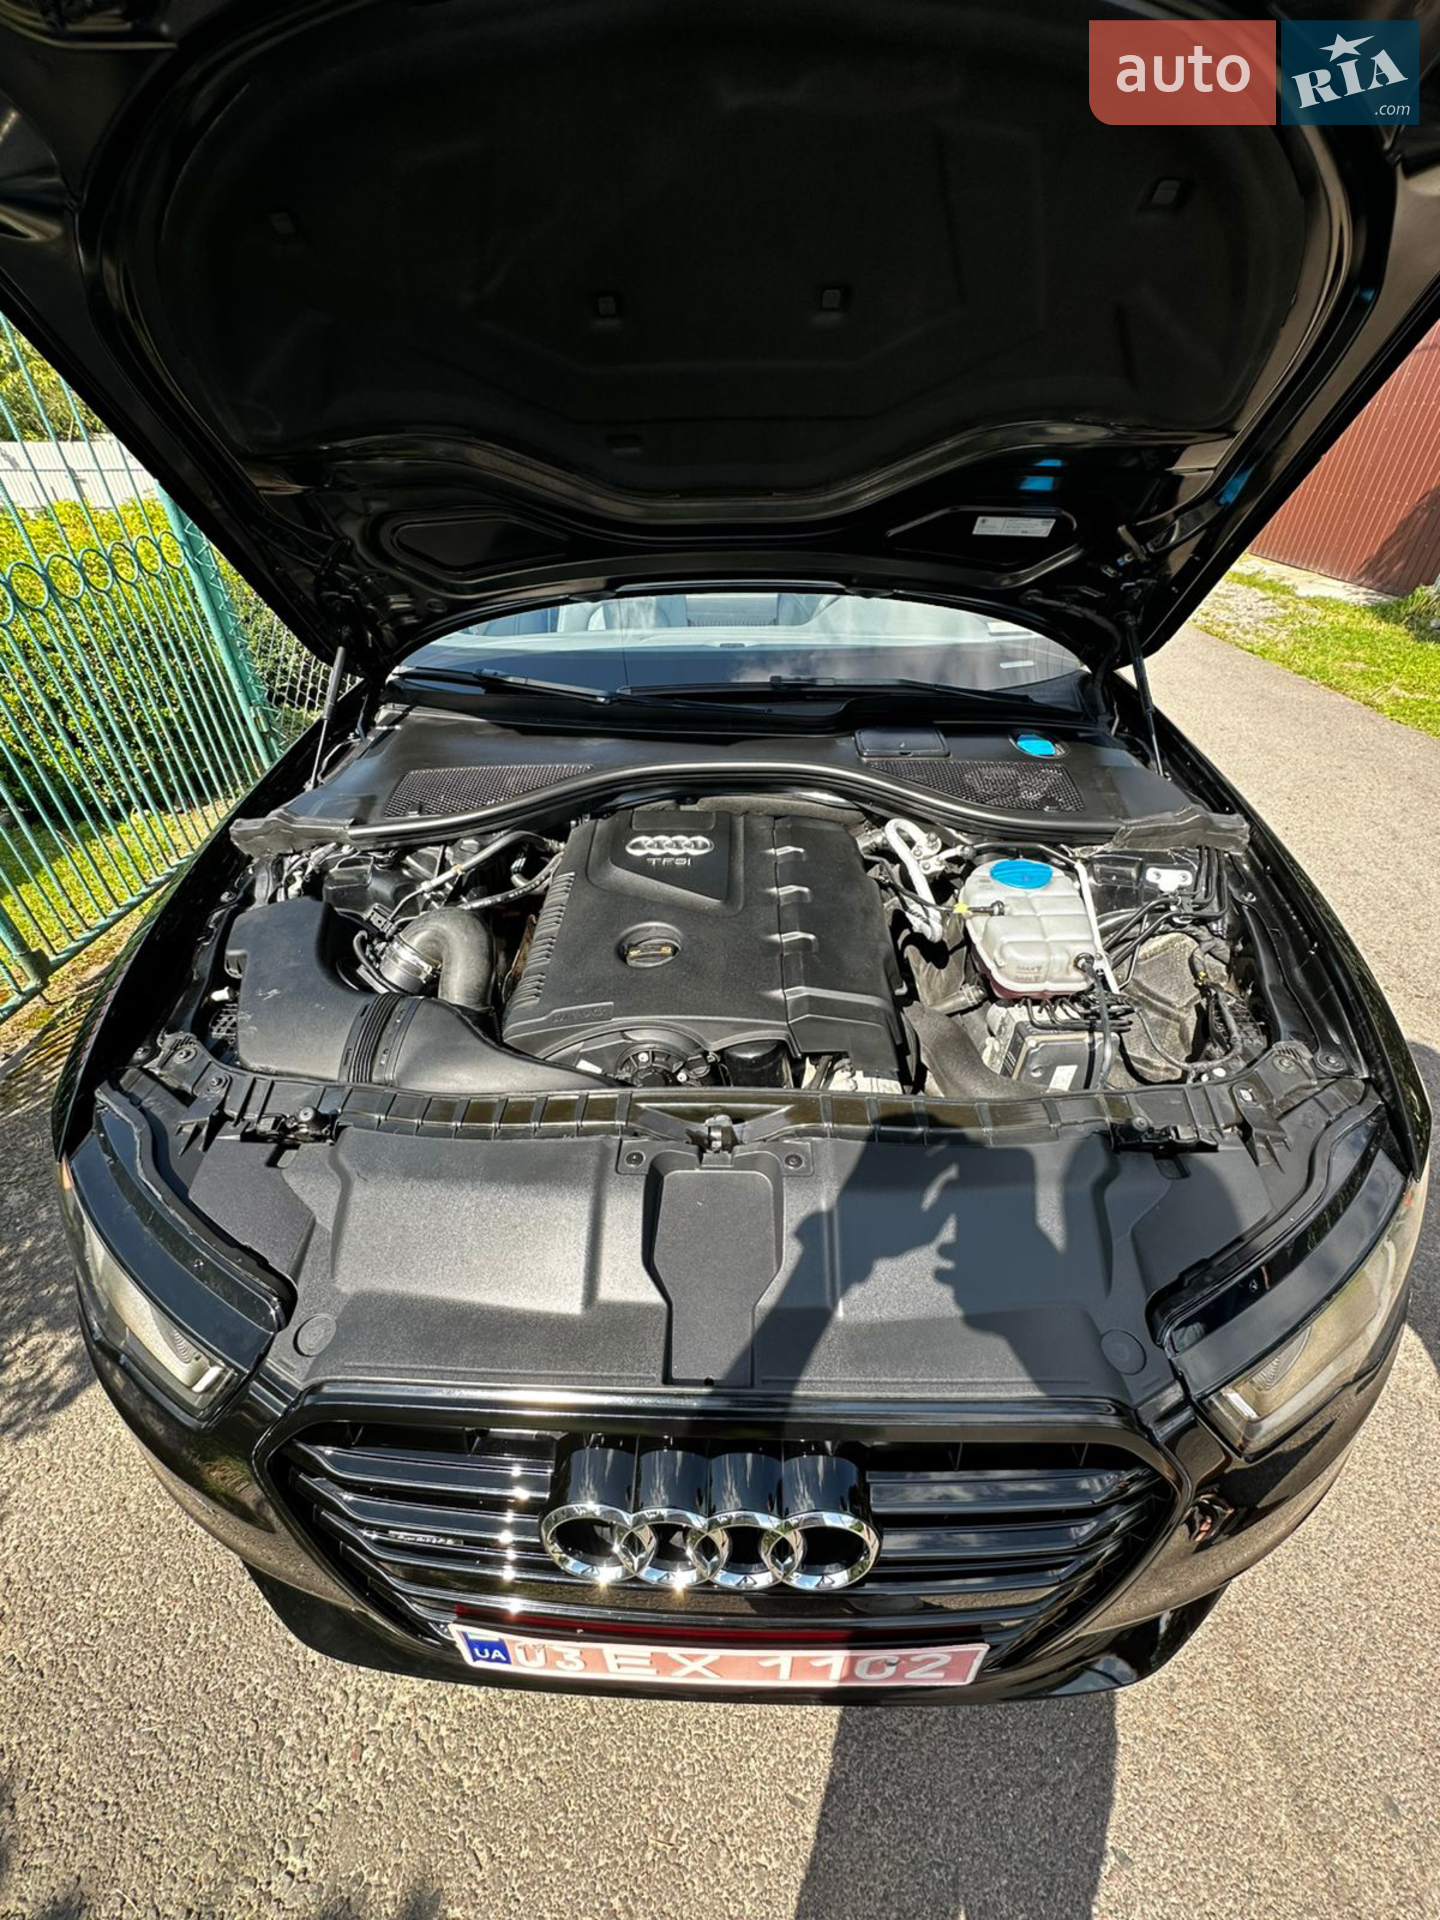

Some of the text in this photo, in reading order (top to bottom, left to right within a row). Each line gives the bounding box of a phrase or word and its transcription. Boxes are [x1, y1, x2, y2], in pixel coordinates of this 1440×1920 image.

[646, 857, 691, 866] TFSI
[474, 1648, 507, 1661] UA
[602, 1649, 721, 1678] EX
[758, 1653, 952, 1681] 1102
